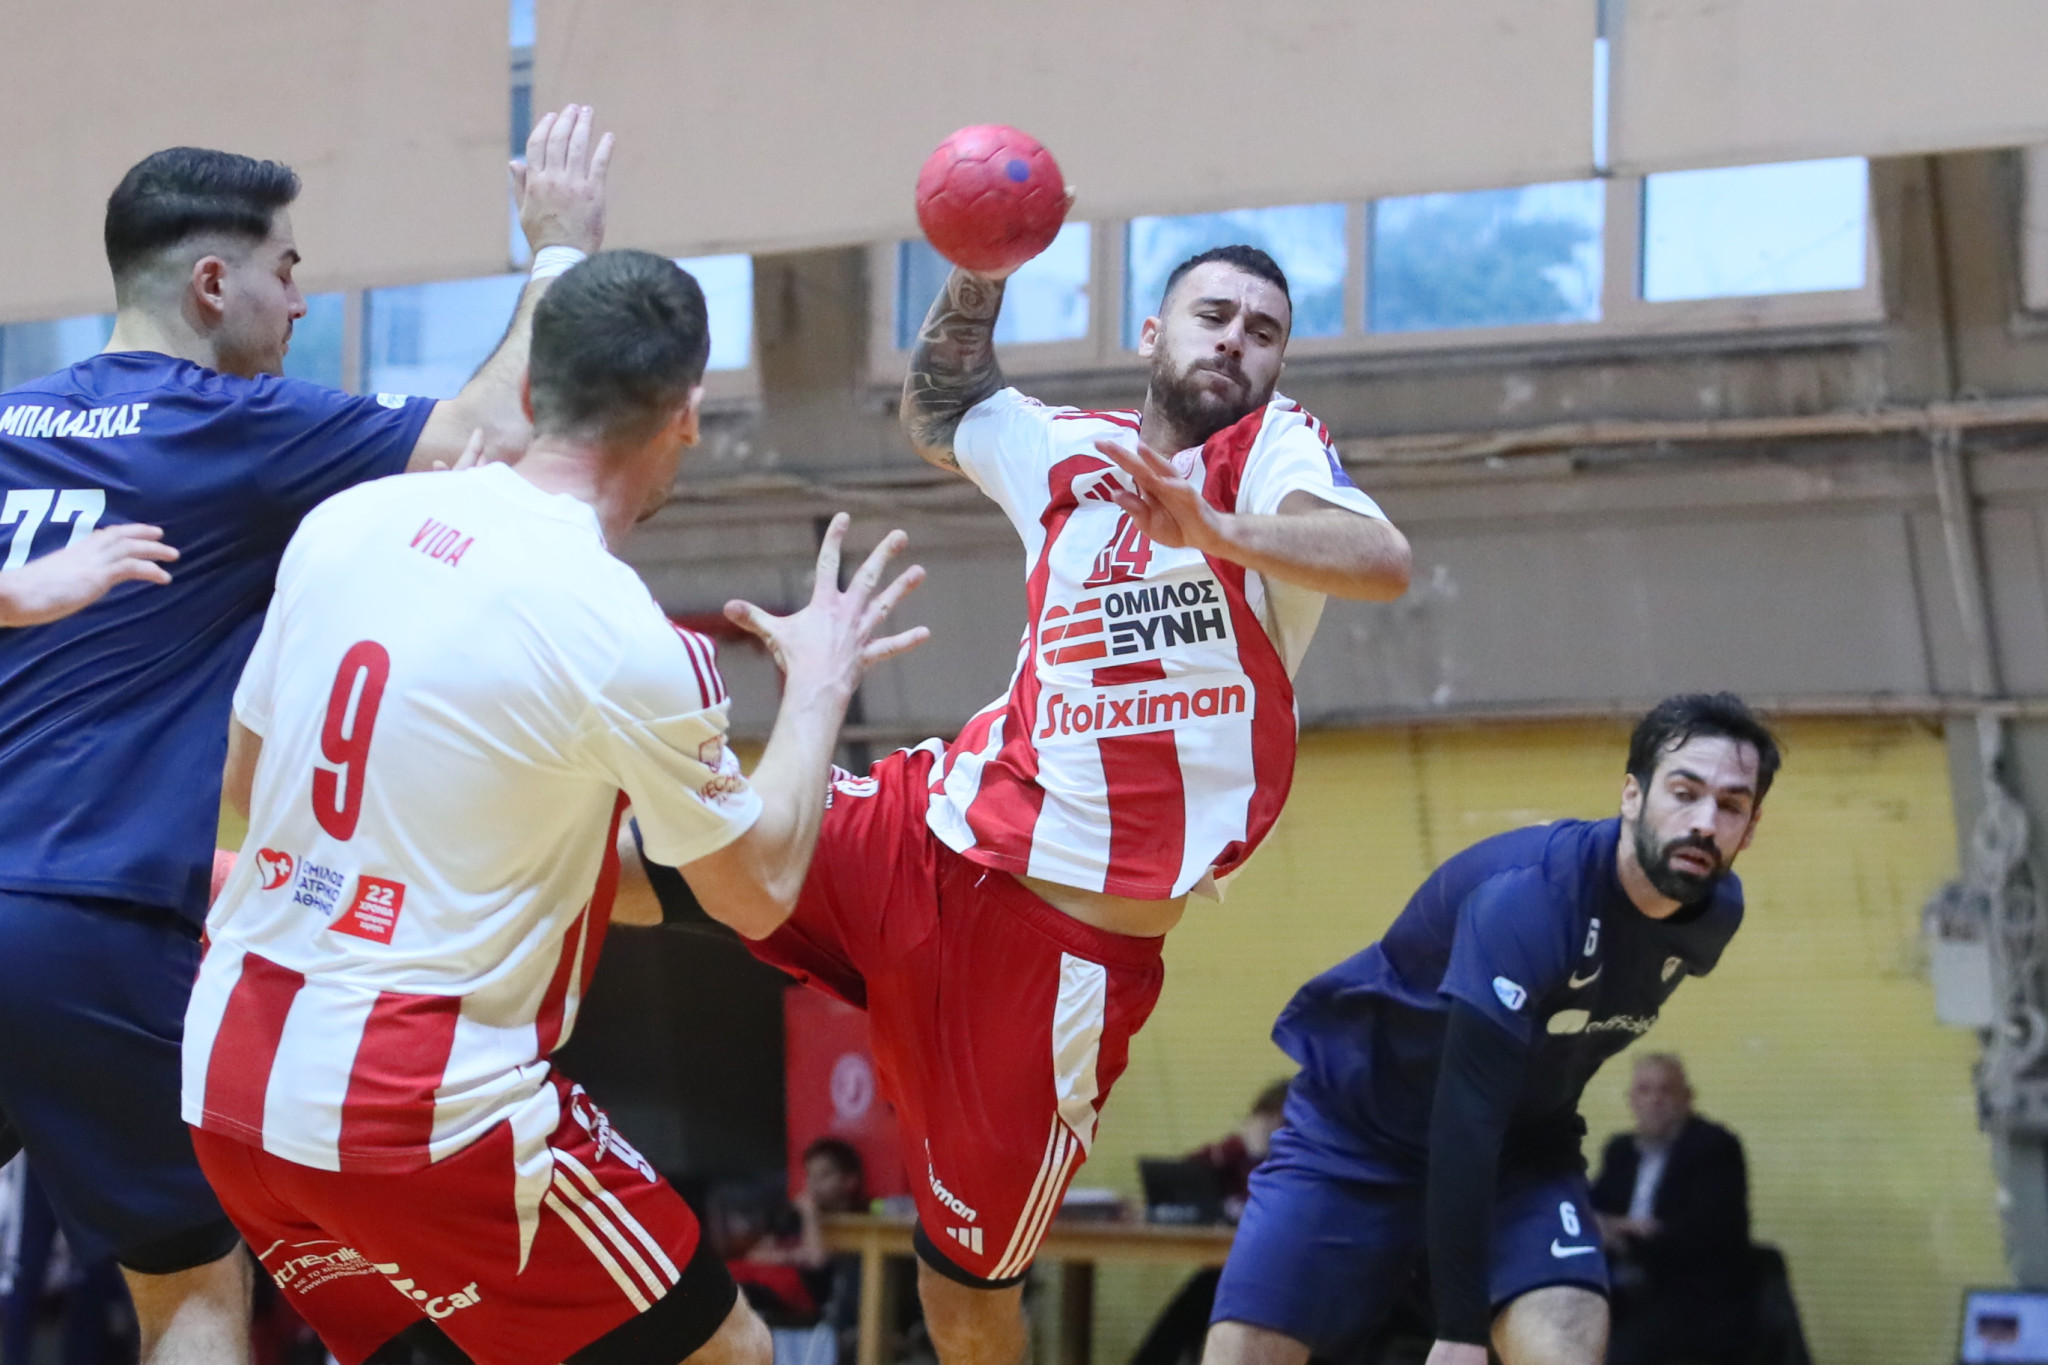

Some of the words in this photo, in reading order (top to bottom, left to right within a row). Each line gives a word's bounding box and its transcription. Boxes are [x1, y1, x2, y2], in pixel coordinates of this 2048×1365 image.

[0, 488, 106, 572] 77
[409, 517, 475, 568] VIDA
[1104, 579, 1219, 618] ΟΜΙΛΟΣ
[1109, 608, 1227, 656] ΞΥΝΗ
[1039, 684, 1246, 739] Stoiximan
[312, 640, 390, 841] 9
[365, 884, 395, 906] 22
[1583, 917, 1601, 957] 6
[1559, 1201, 1581, 1237] 6
